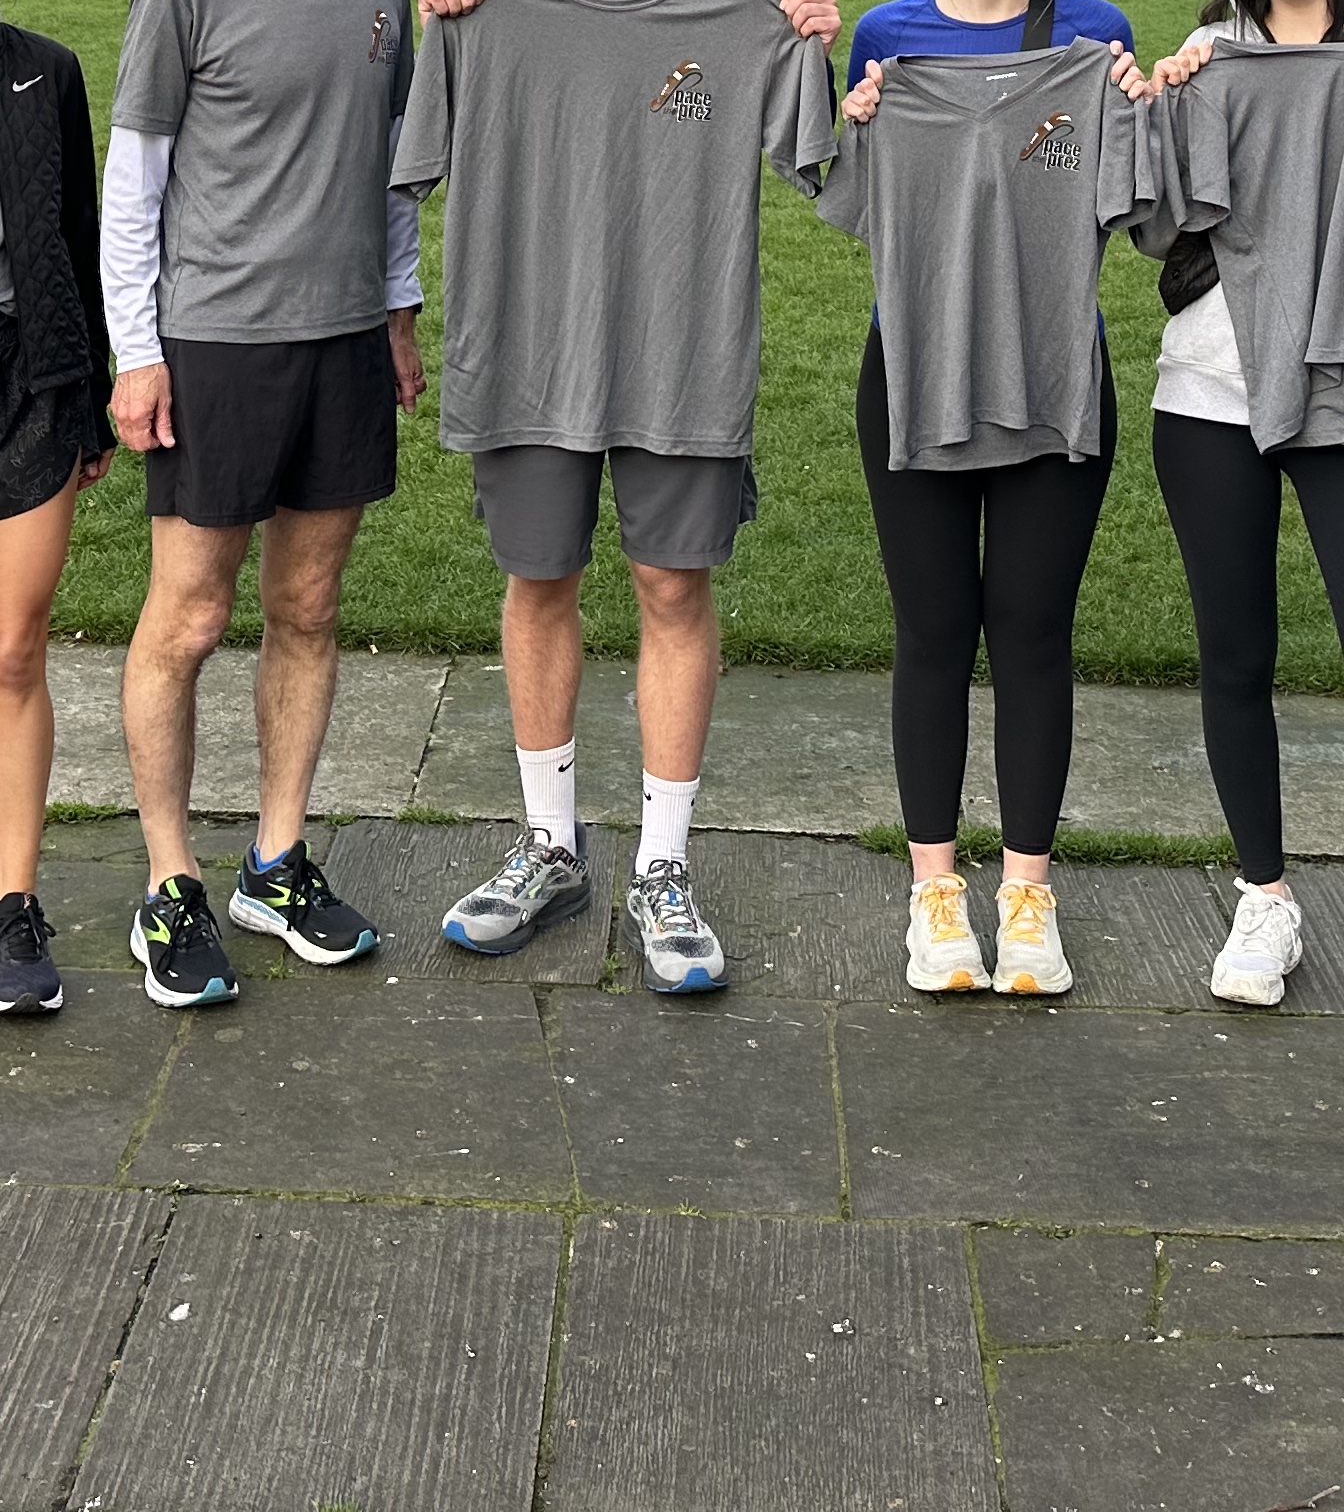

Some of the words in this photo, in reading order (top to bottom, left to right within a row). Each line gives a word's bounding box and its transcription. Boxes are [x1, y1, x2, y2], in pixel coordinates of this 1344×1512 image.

[673, 90, 712, 108] pace
[677, 105, 712, 122] prez
[1042, 139, 1081, 157] pace
[1045, 153, 1081, 172] prez
